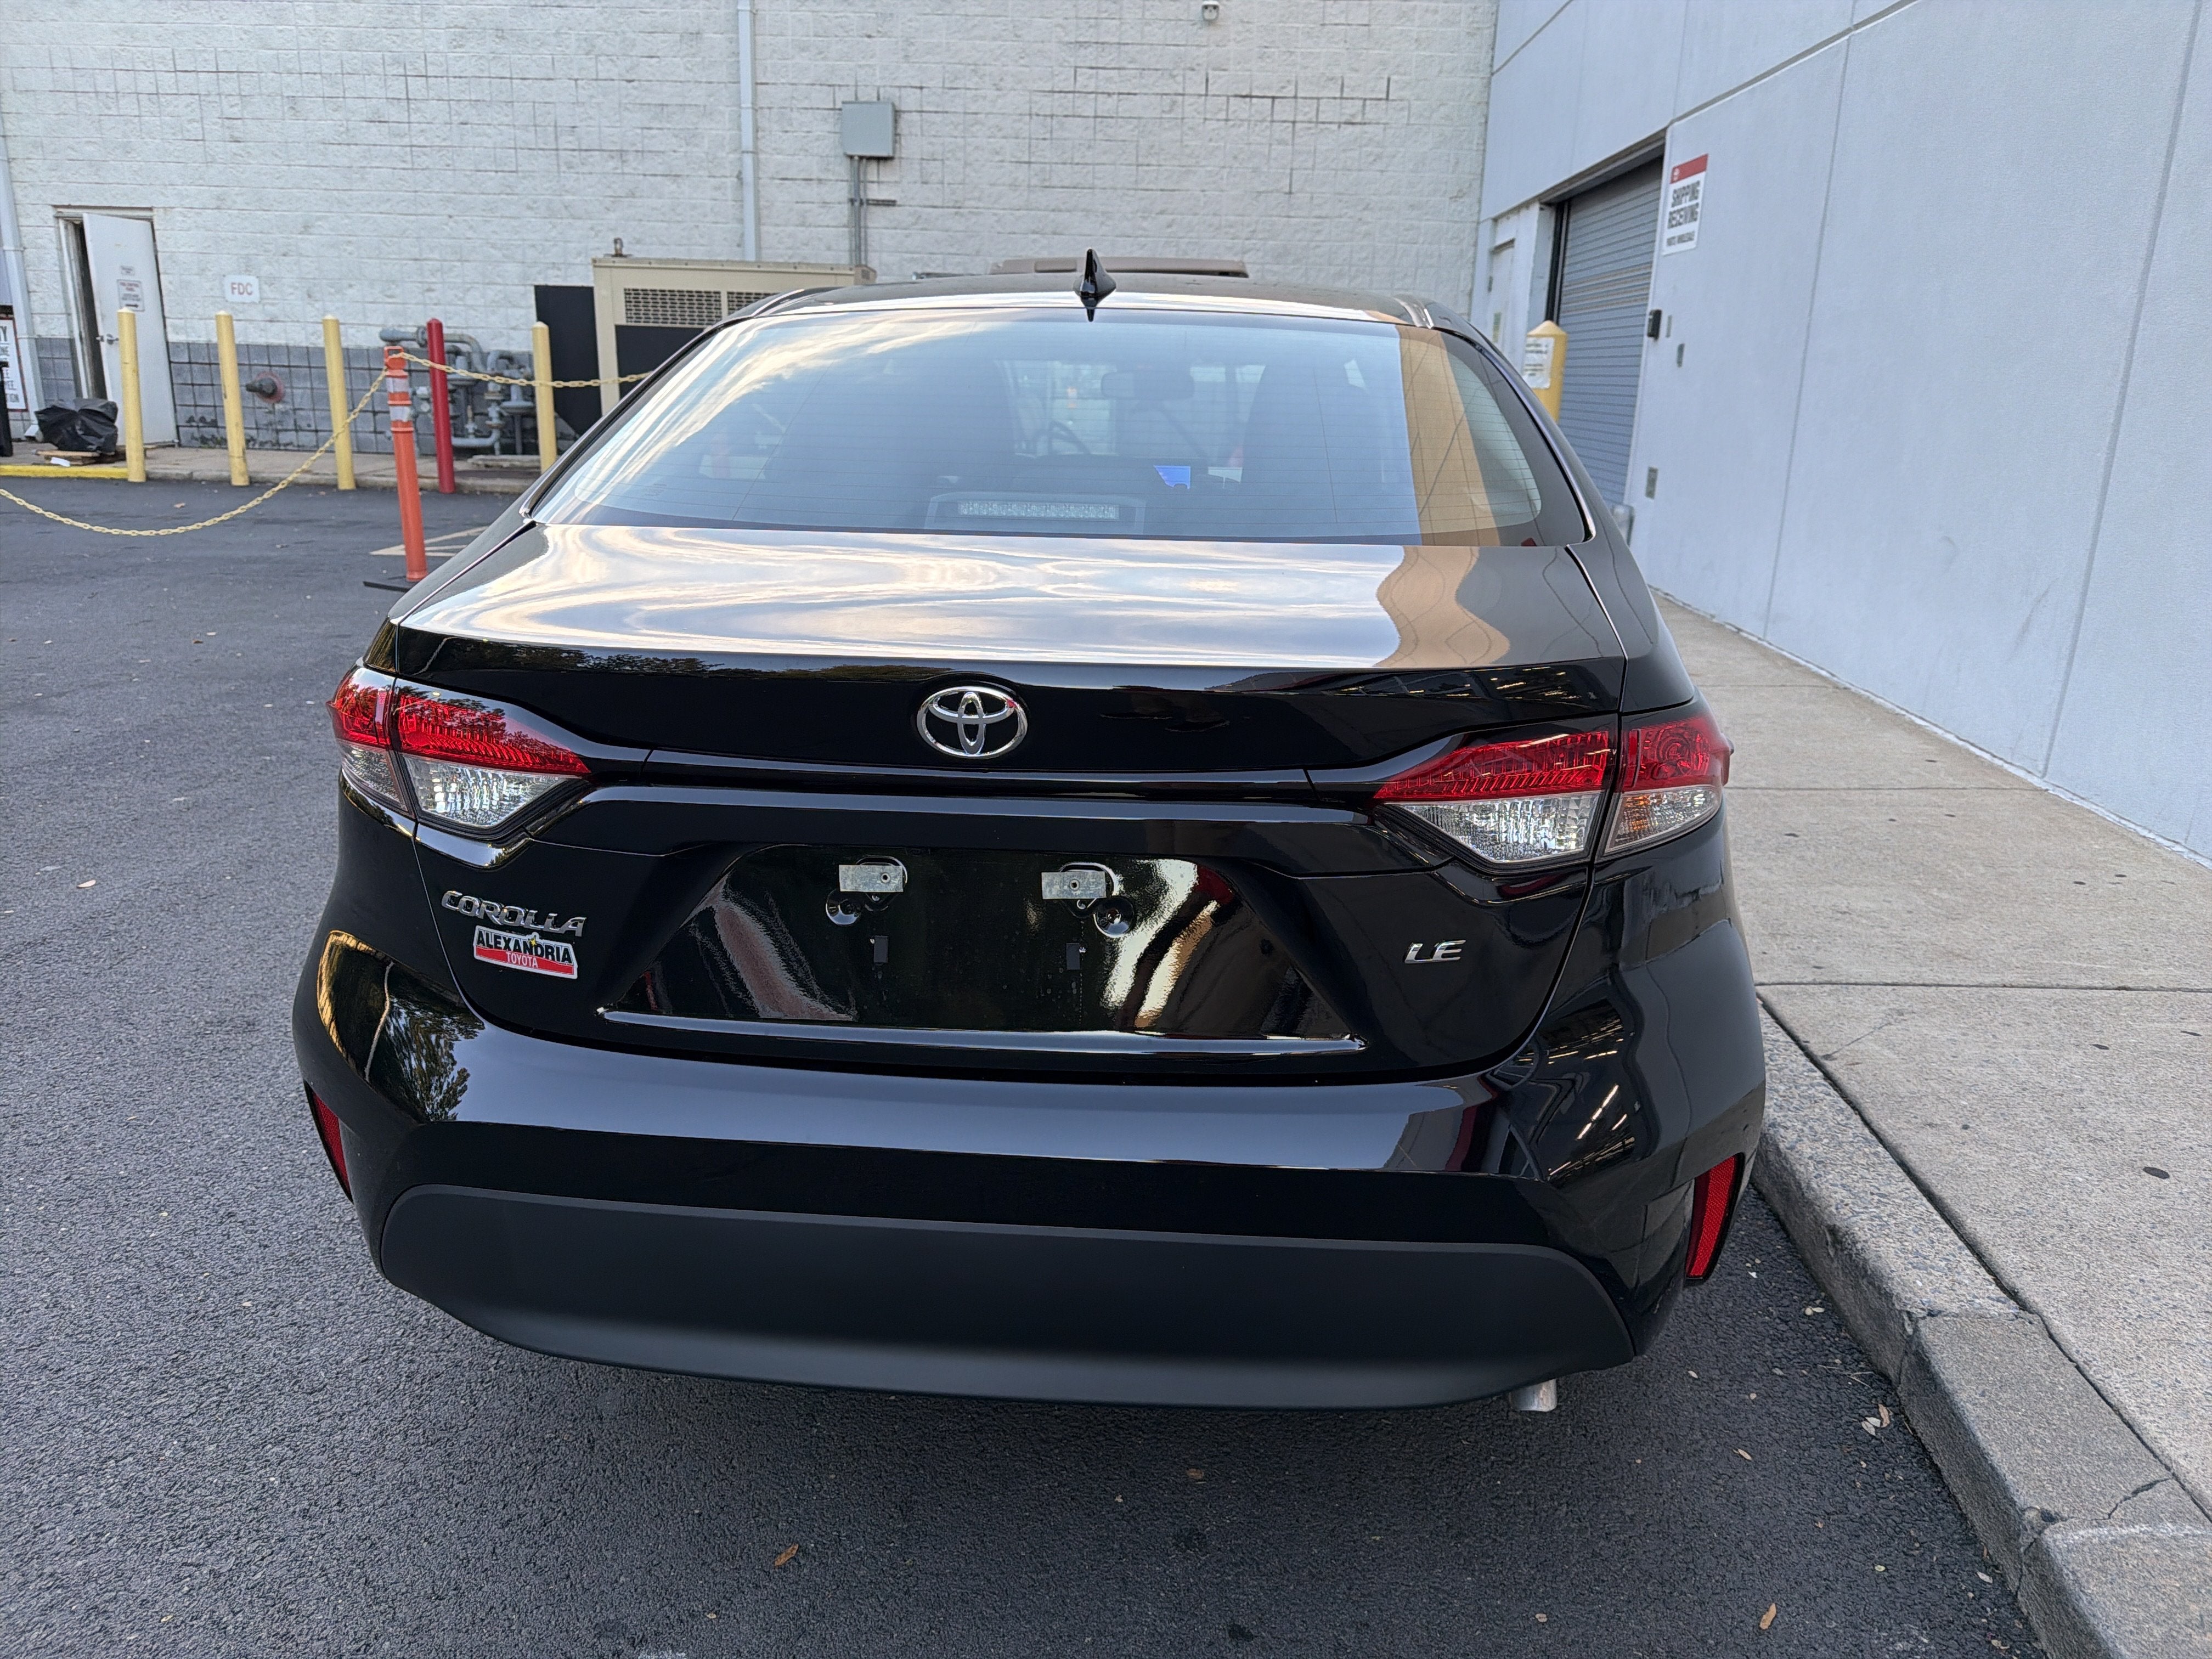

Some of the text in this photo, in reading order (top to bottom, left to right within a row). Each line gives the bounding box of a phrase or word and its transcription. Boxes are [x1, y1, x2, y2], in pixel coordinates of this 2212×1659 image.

[1672, 180, 1700, 207] SHIPPING
[1668, 202, 1699, 229] RECEIVING
[230, 283, 253, 295] FDC
[441, 890, 587, 937] COROLLA
[476, 930, 573, 964] ALEXANDRIA
[505, 951, 538, 968] TOYOTA
[1404, 940, 1466, 964] LE
